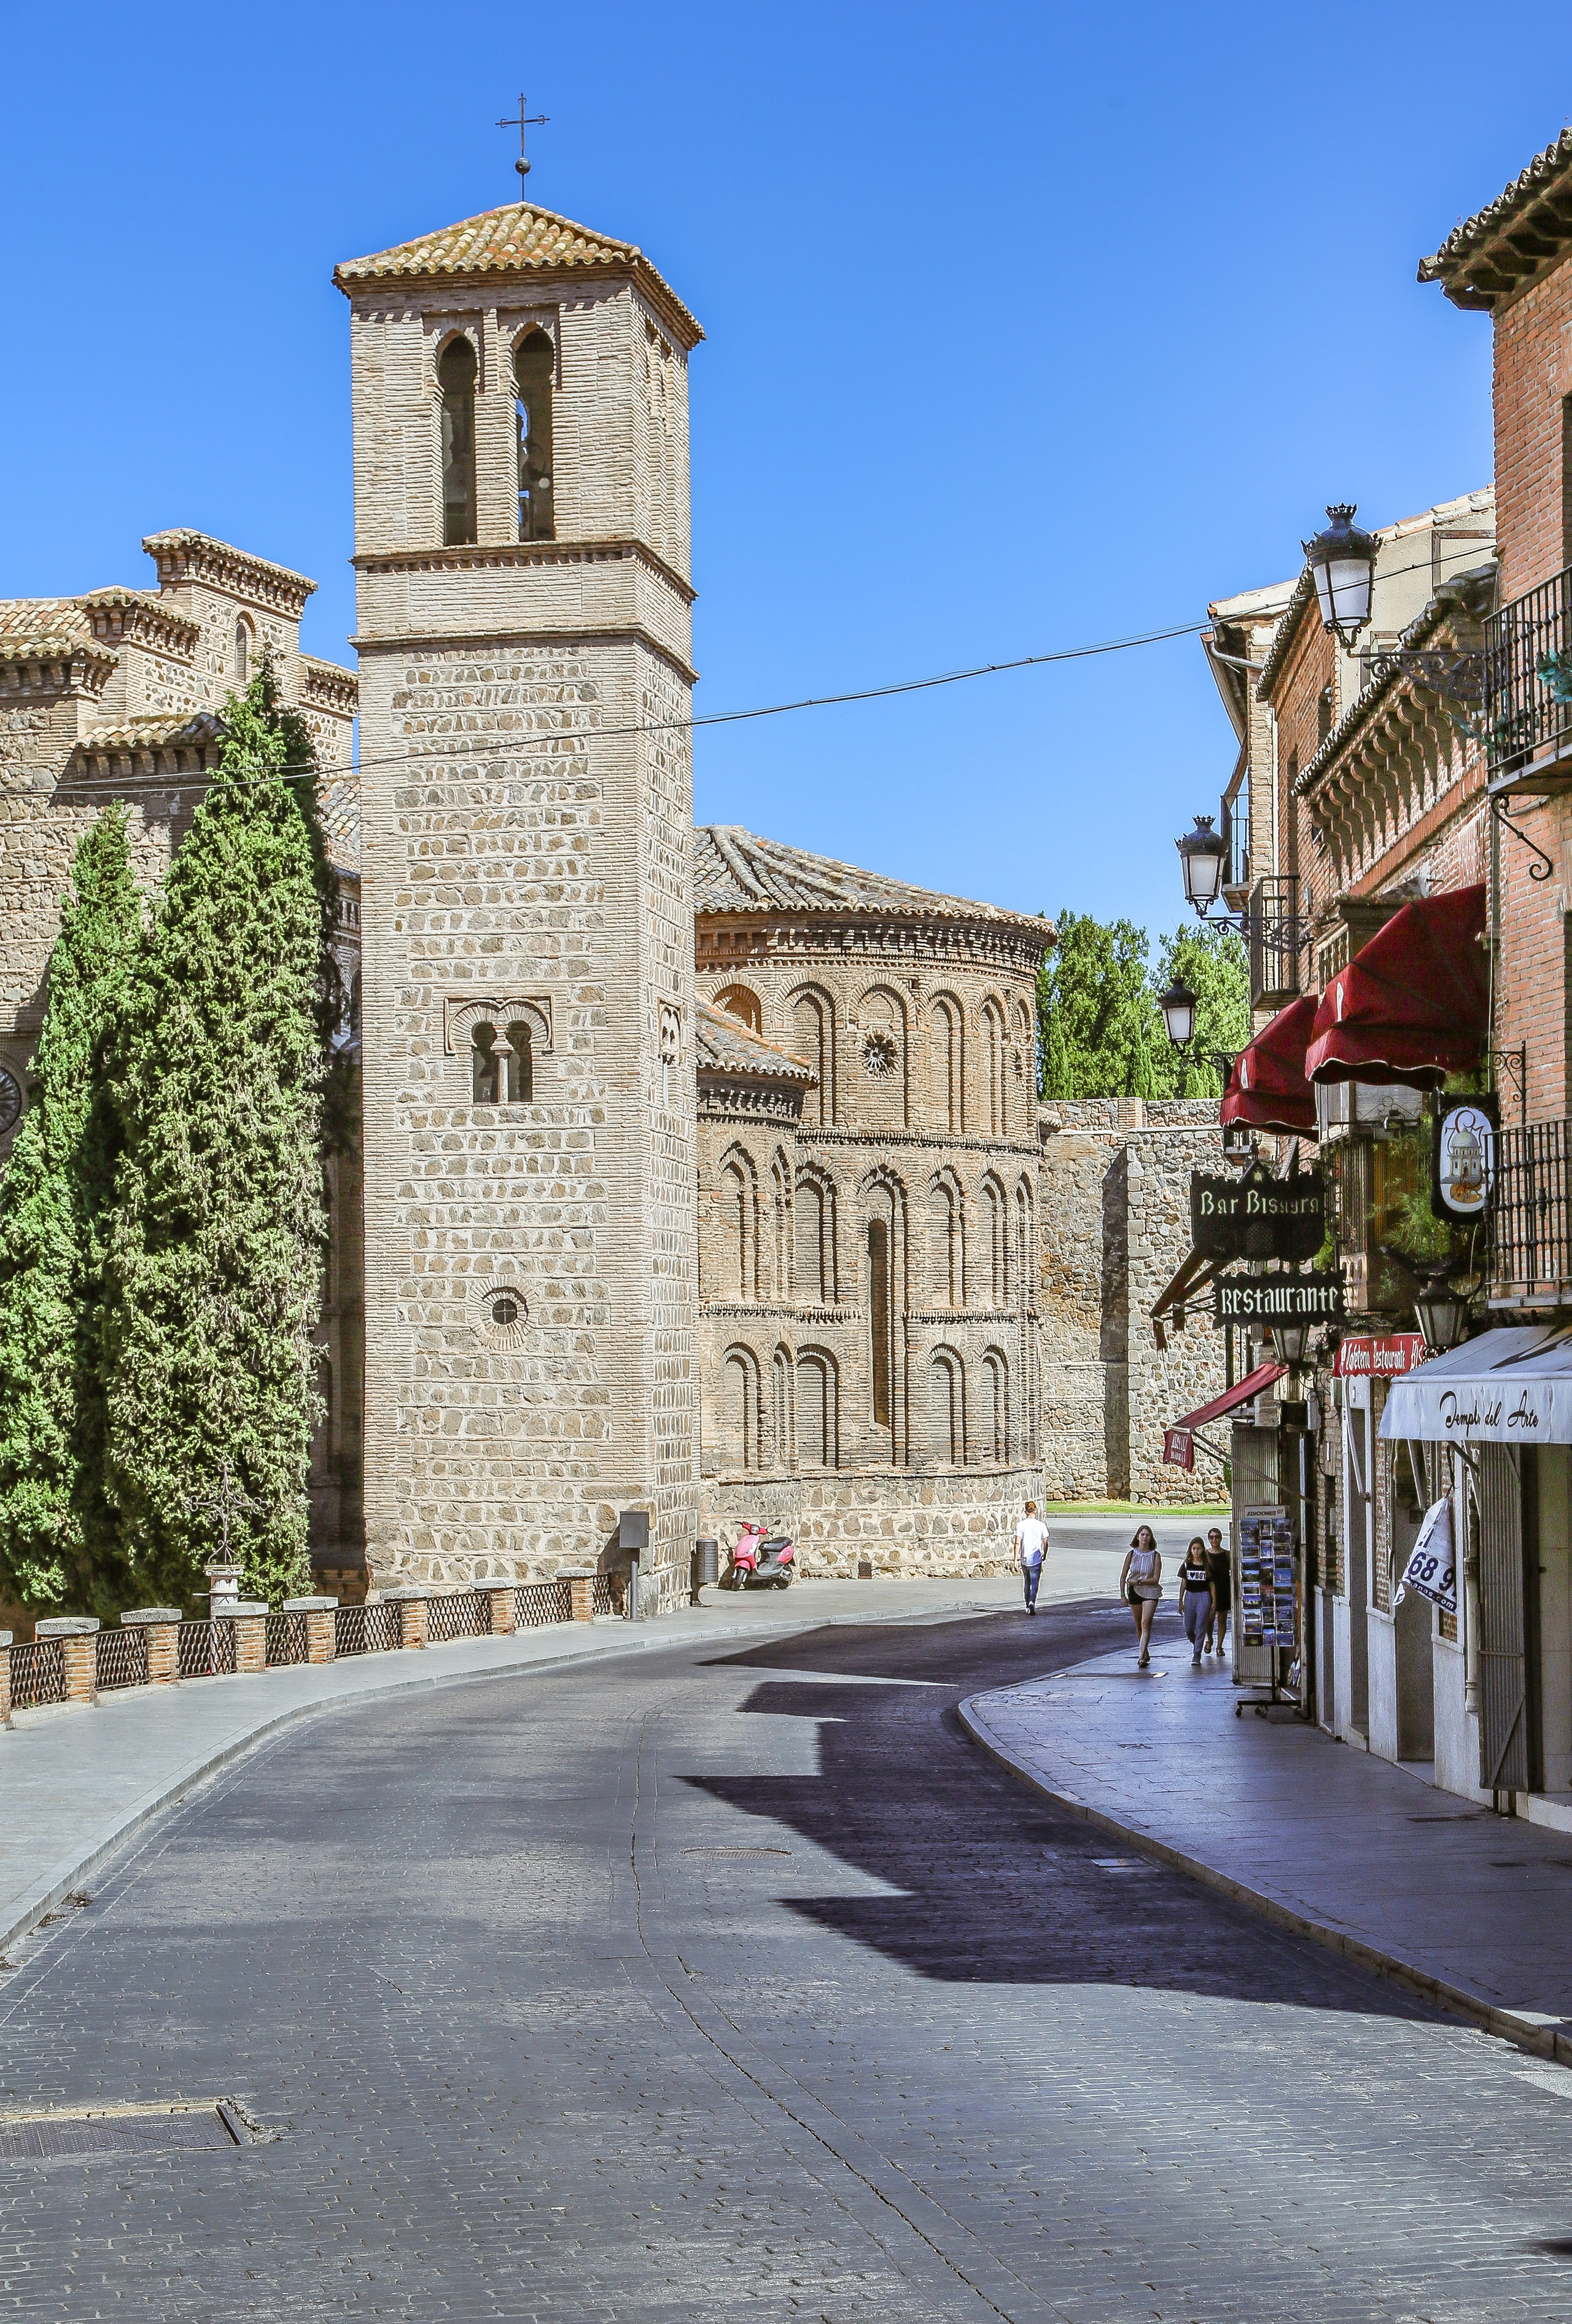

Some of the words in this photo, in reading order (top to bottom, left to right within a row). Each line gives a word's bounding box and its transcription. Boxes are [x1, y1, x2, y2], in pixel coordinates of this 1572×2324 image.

[1200, 1190, 1239, 1215] Bar
[1247, 1189, 1319, 1214] Bisagra
[1221, 1285, 1339, 1314] Restaurante
[1484, 1400, 1502, 1427] del
[1507, 1389, 1539, 1429] Arte
